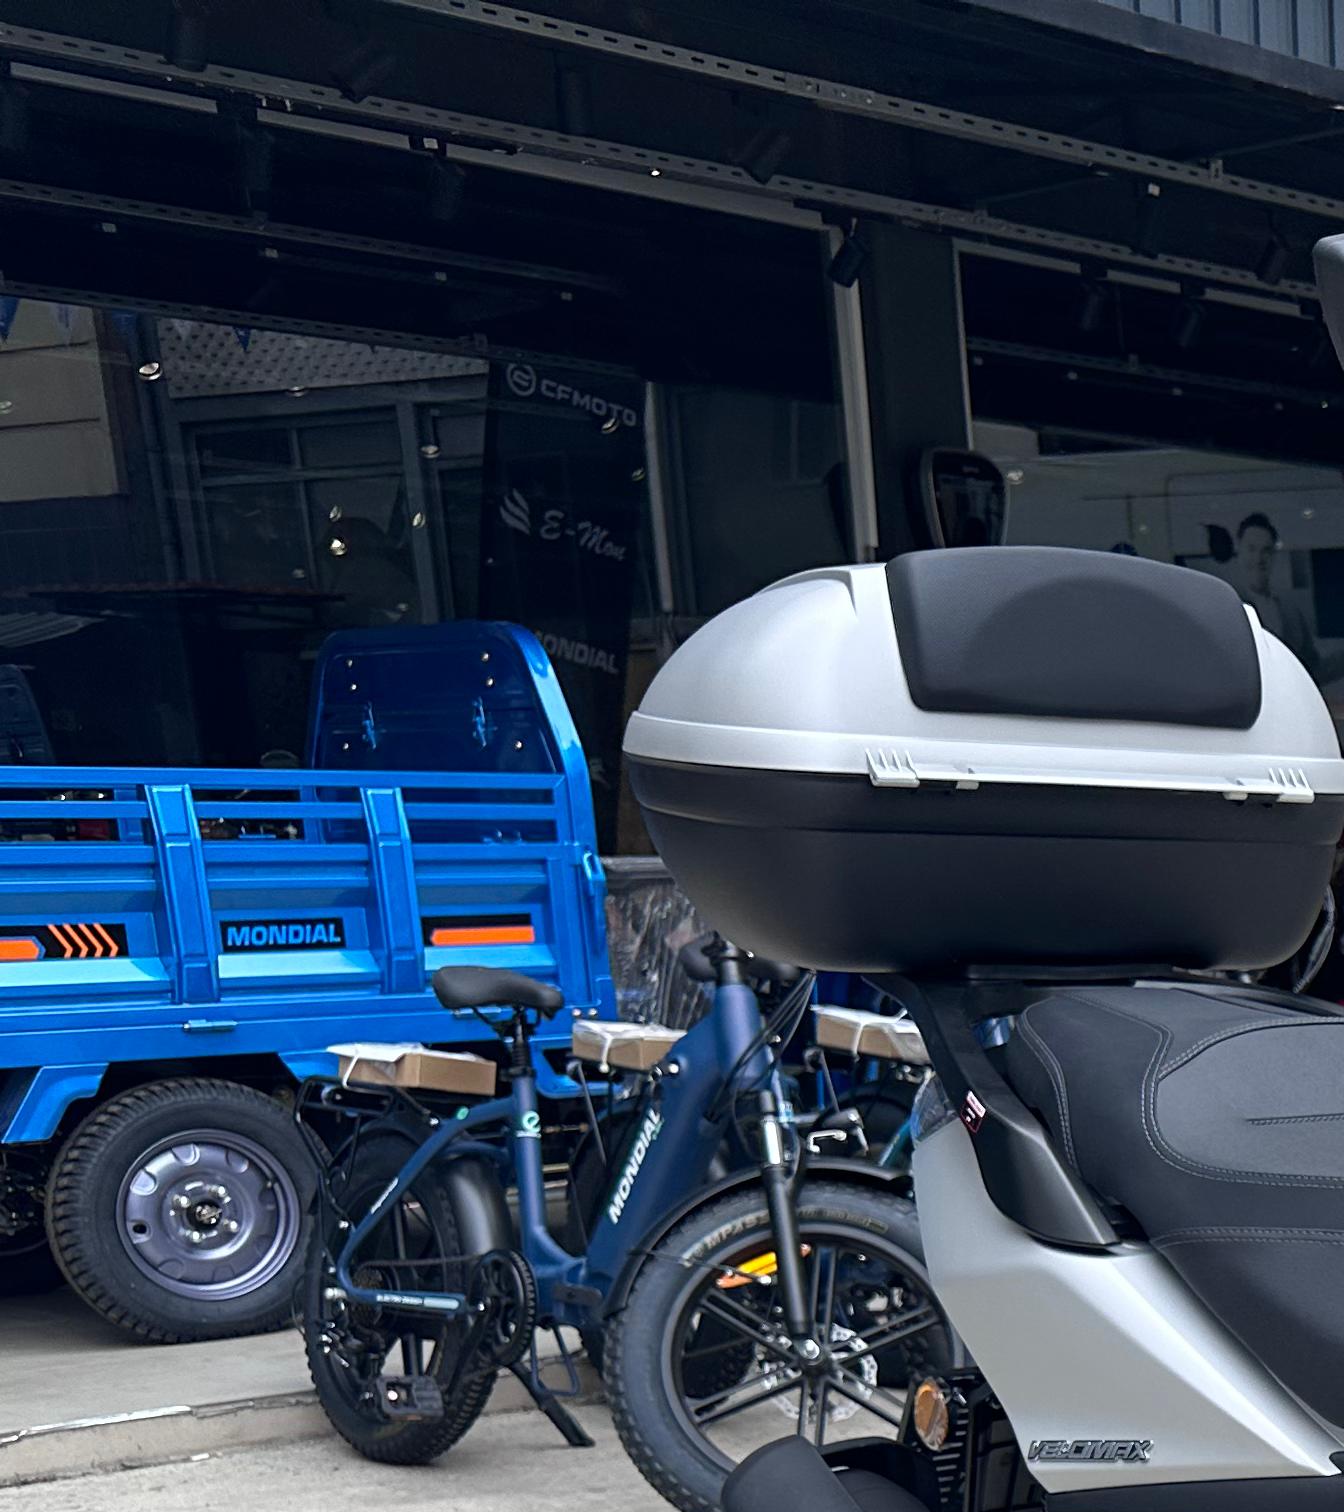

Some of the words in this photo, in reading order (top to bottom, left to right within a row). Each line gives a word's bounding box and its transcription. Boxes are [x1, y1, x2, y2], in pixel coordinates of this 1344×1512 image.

[540, 378, 637, 428] CFMOTO
[226, 924, 341, 946] MONDIAL
[606, 1107, 663, 1225] MONDIAL
